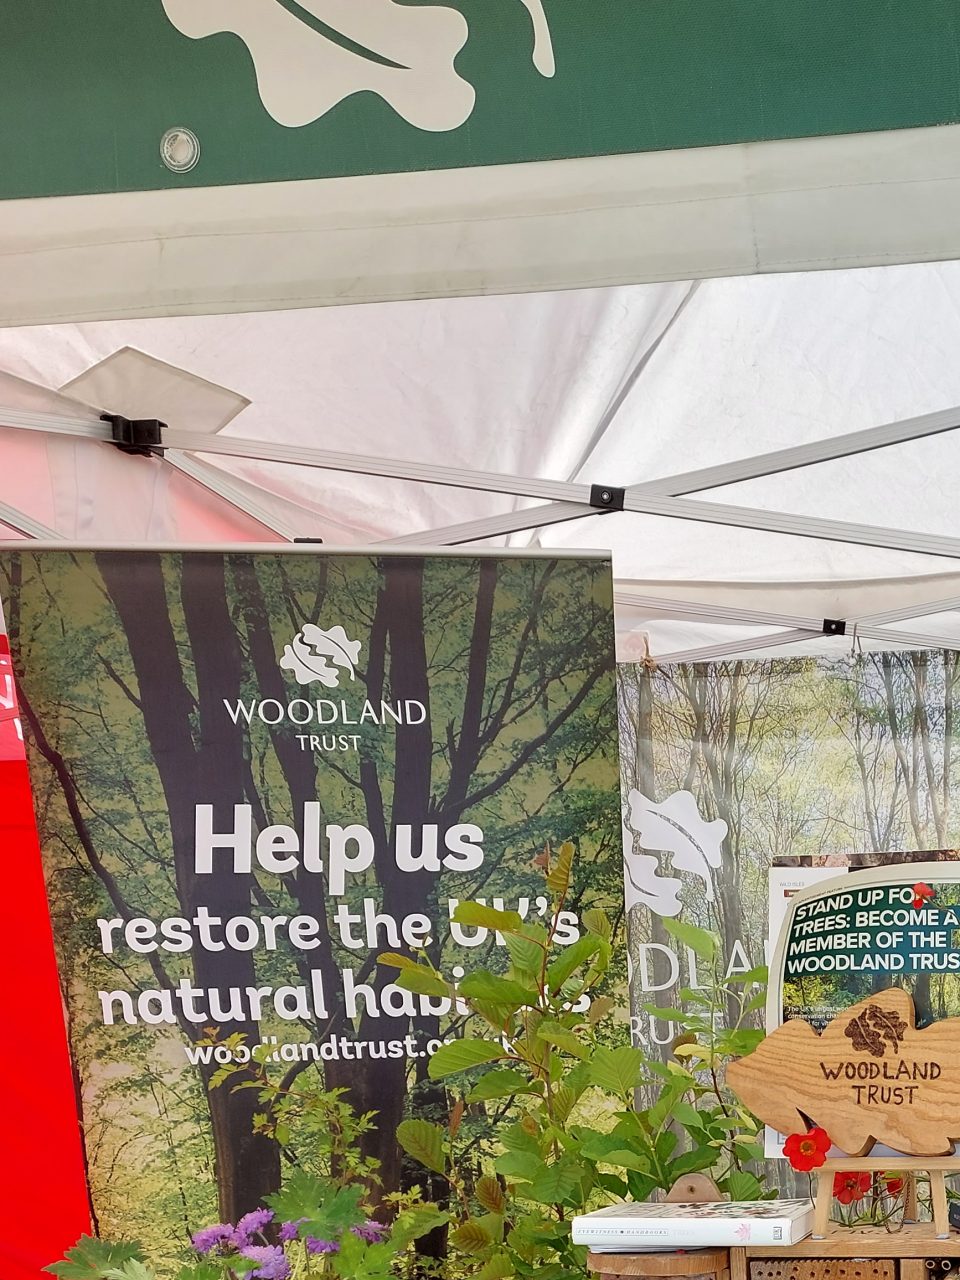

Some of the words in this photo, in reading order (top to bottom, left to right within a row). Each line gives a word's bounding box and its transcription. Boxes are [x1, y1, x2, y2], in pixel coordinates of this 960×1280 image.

[223, 698, 427, 726] WOODLAND
[295, 734, 361, 751] TRUST
[194, 801, 375, 895] Help
[393, 822, 485, 872] us
[795, 891, 853, 921] STAND
[858, 887, 884, 907] UP
[889, 886, 928, 905] FO
[97, 906, 321, 954] restore
[333, 897, 437, 949] the
[793, 915, 851, 938] TREES:
[855, 909, 939, 928] BECOME
[943, 909, 959, 926] A
[789, 932, 871, 956] MEMBER
[876, 931, 903, 948] OF
[908, 931, 947, 948] THE
[787, 953, 904, 974] WOODLAND
[97, 968, 329, 1025] natural
[819, 1060, 942, 1080] WOODLAND
[851, 1084, 919, 1106] TRUST
